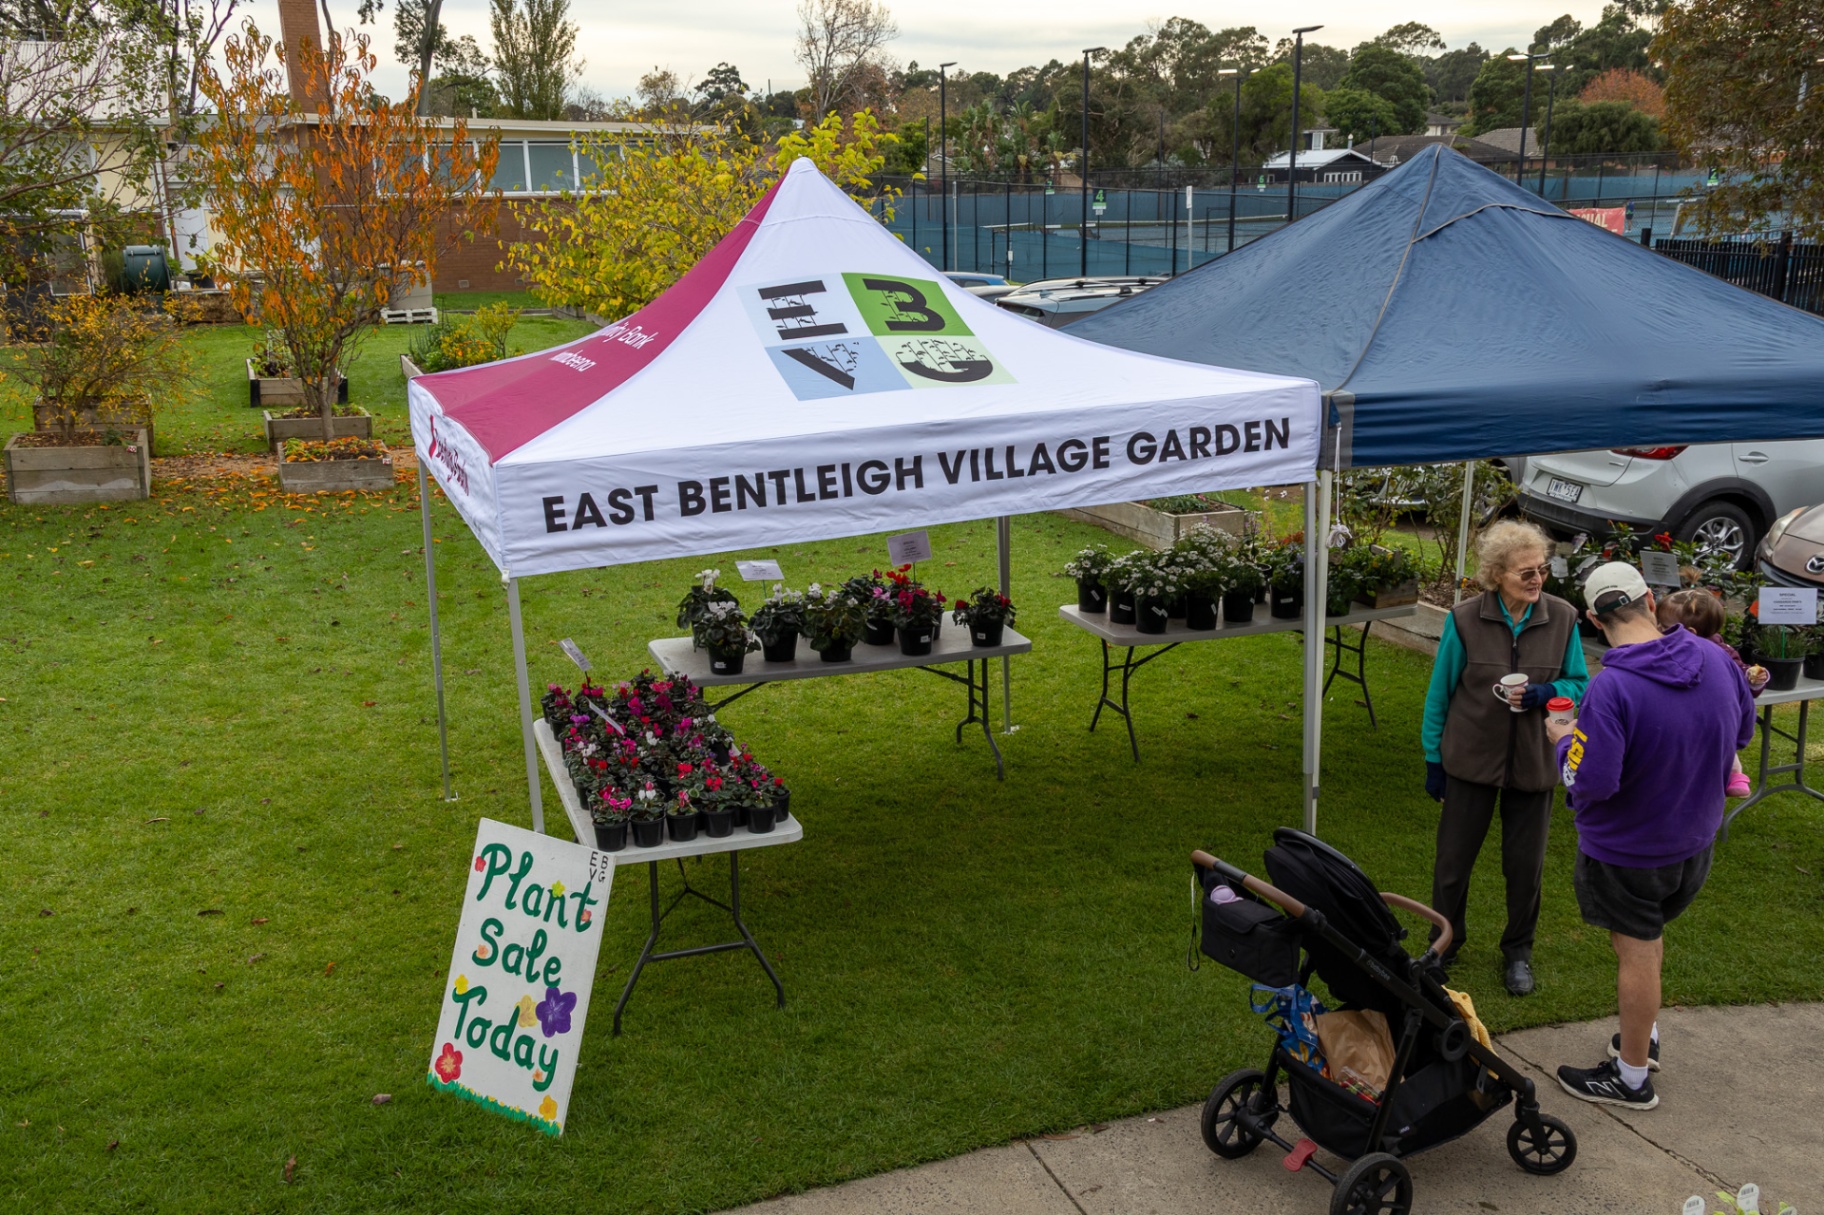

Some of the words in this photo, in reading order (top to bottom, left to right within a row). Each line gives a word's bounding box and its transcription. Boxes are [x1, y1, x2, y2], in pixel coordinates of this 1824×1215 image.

[1096, 189, 1104, 202] 4
[617, 325, 659, 350] Bank
[543, 485, 658, 533] EAST
[678, 455, 923, 516] BENTLEIGH
[937, 436, 1110, 485] VILLAGE
[1127, 418, 1290, 465] GARDEN
[476, 843, 598, 933] Plant
[472, 917, 562, 989] Sale
[452, 985, 559, 1092] Today
